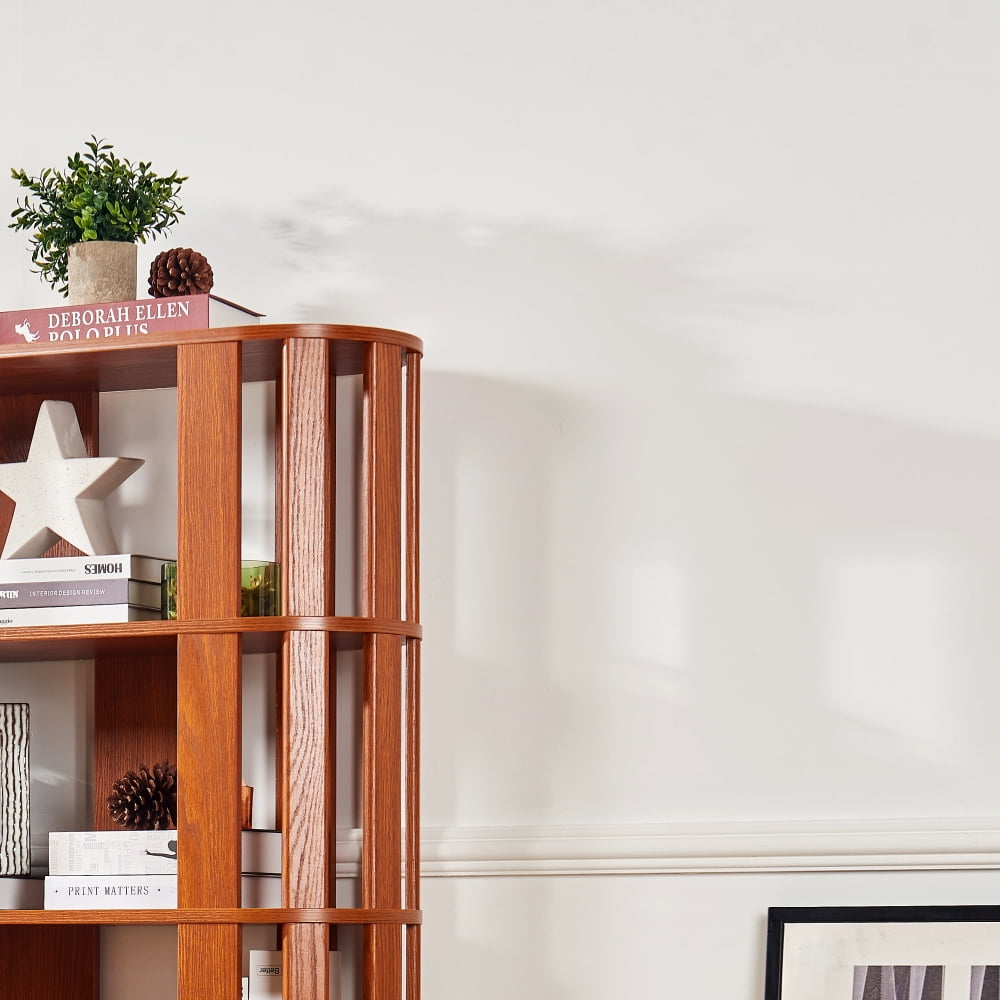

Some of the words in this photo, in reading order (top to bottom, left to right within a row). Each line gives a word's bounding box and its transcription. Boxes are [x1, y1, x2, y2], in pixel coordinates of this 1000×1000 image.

[48, 306, 130, 329] DEBORAH
[136, 301, 190, 321] ELLEN
[84, 563, 123, 575] HOMES
[29, 590, 58, 598] INTERIOR
[58, 589, 81, 597] DESIGN
[81, 588, 106, 596] REVIEW
[68, 886, 100, 896] PRINT
[104, 885, 150, 896] MATTERS
